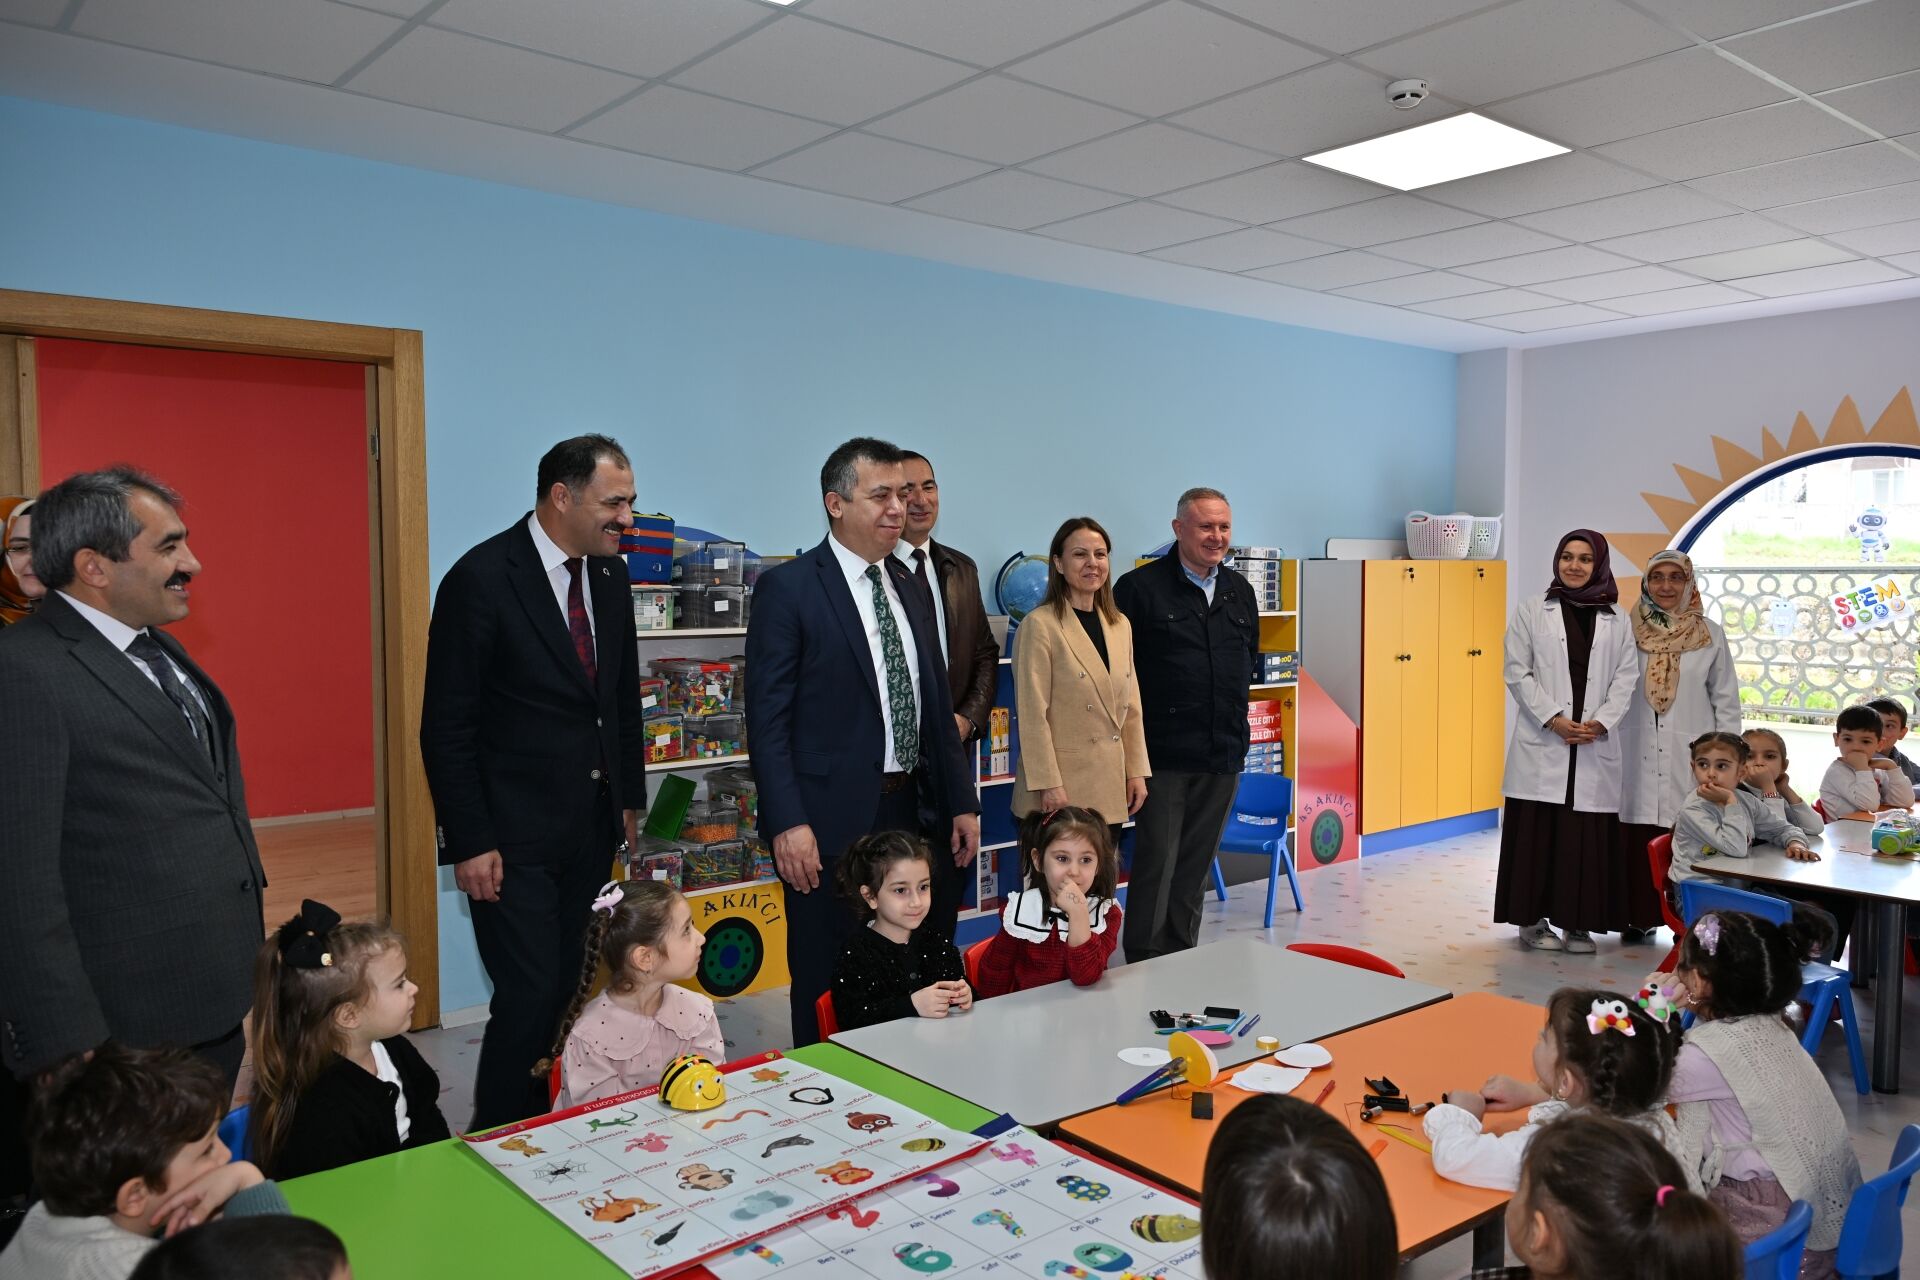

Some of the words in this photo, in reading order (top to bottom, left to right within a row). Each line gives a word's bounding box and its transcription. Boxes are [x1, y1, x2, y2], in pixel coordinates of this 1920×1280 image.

[1834, 579, 1901, 615] STEM
[1248, 716, 1262, 726] ZZLE
[1250, 730, 1263, 740] ZZLE
[1010, 1177, 1032, 1189] Eight
[929, 1207, 956, 1221] Seven
